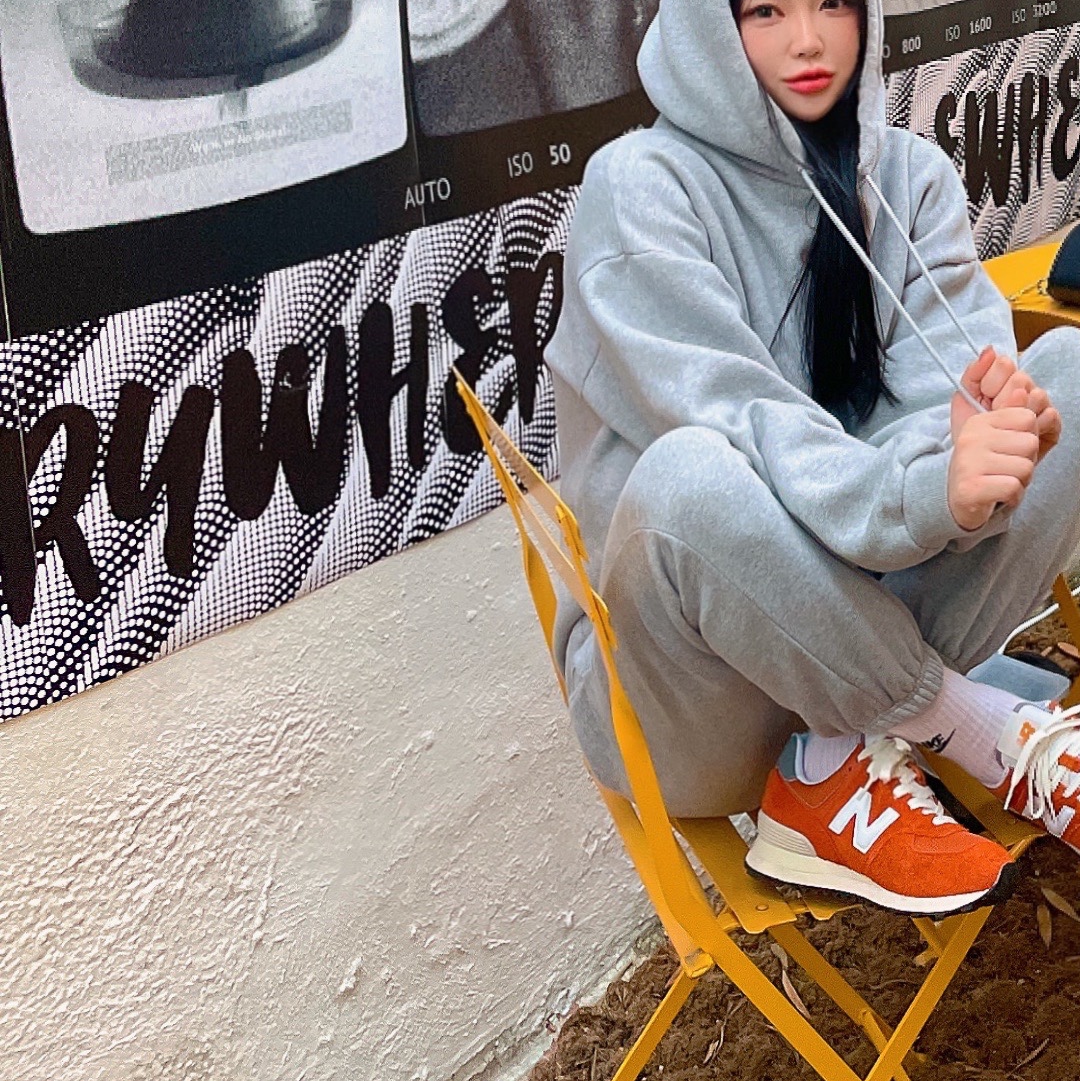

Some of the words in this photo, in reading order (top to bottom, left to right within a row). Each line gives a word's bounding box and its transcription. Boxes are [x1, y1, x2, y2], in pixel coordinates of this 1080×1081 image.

[945, 25, 961, 42] ISO
[969, 16, 992, 35] 1600
[1012, 9, 1026, 24] ISO
[901, 36, 921, 54] 800
[507, 151, 535, 178] ISO
[549, 143, 571, 165] 50
[404, 177, 451, 210] AUTO
[828, 786, 901, 855] N
